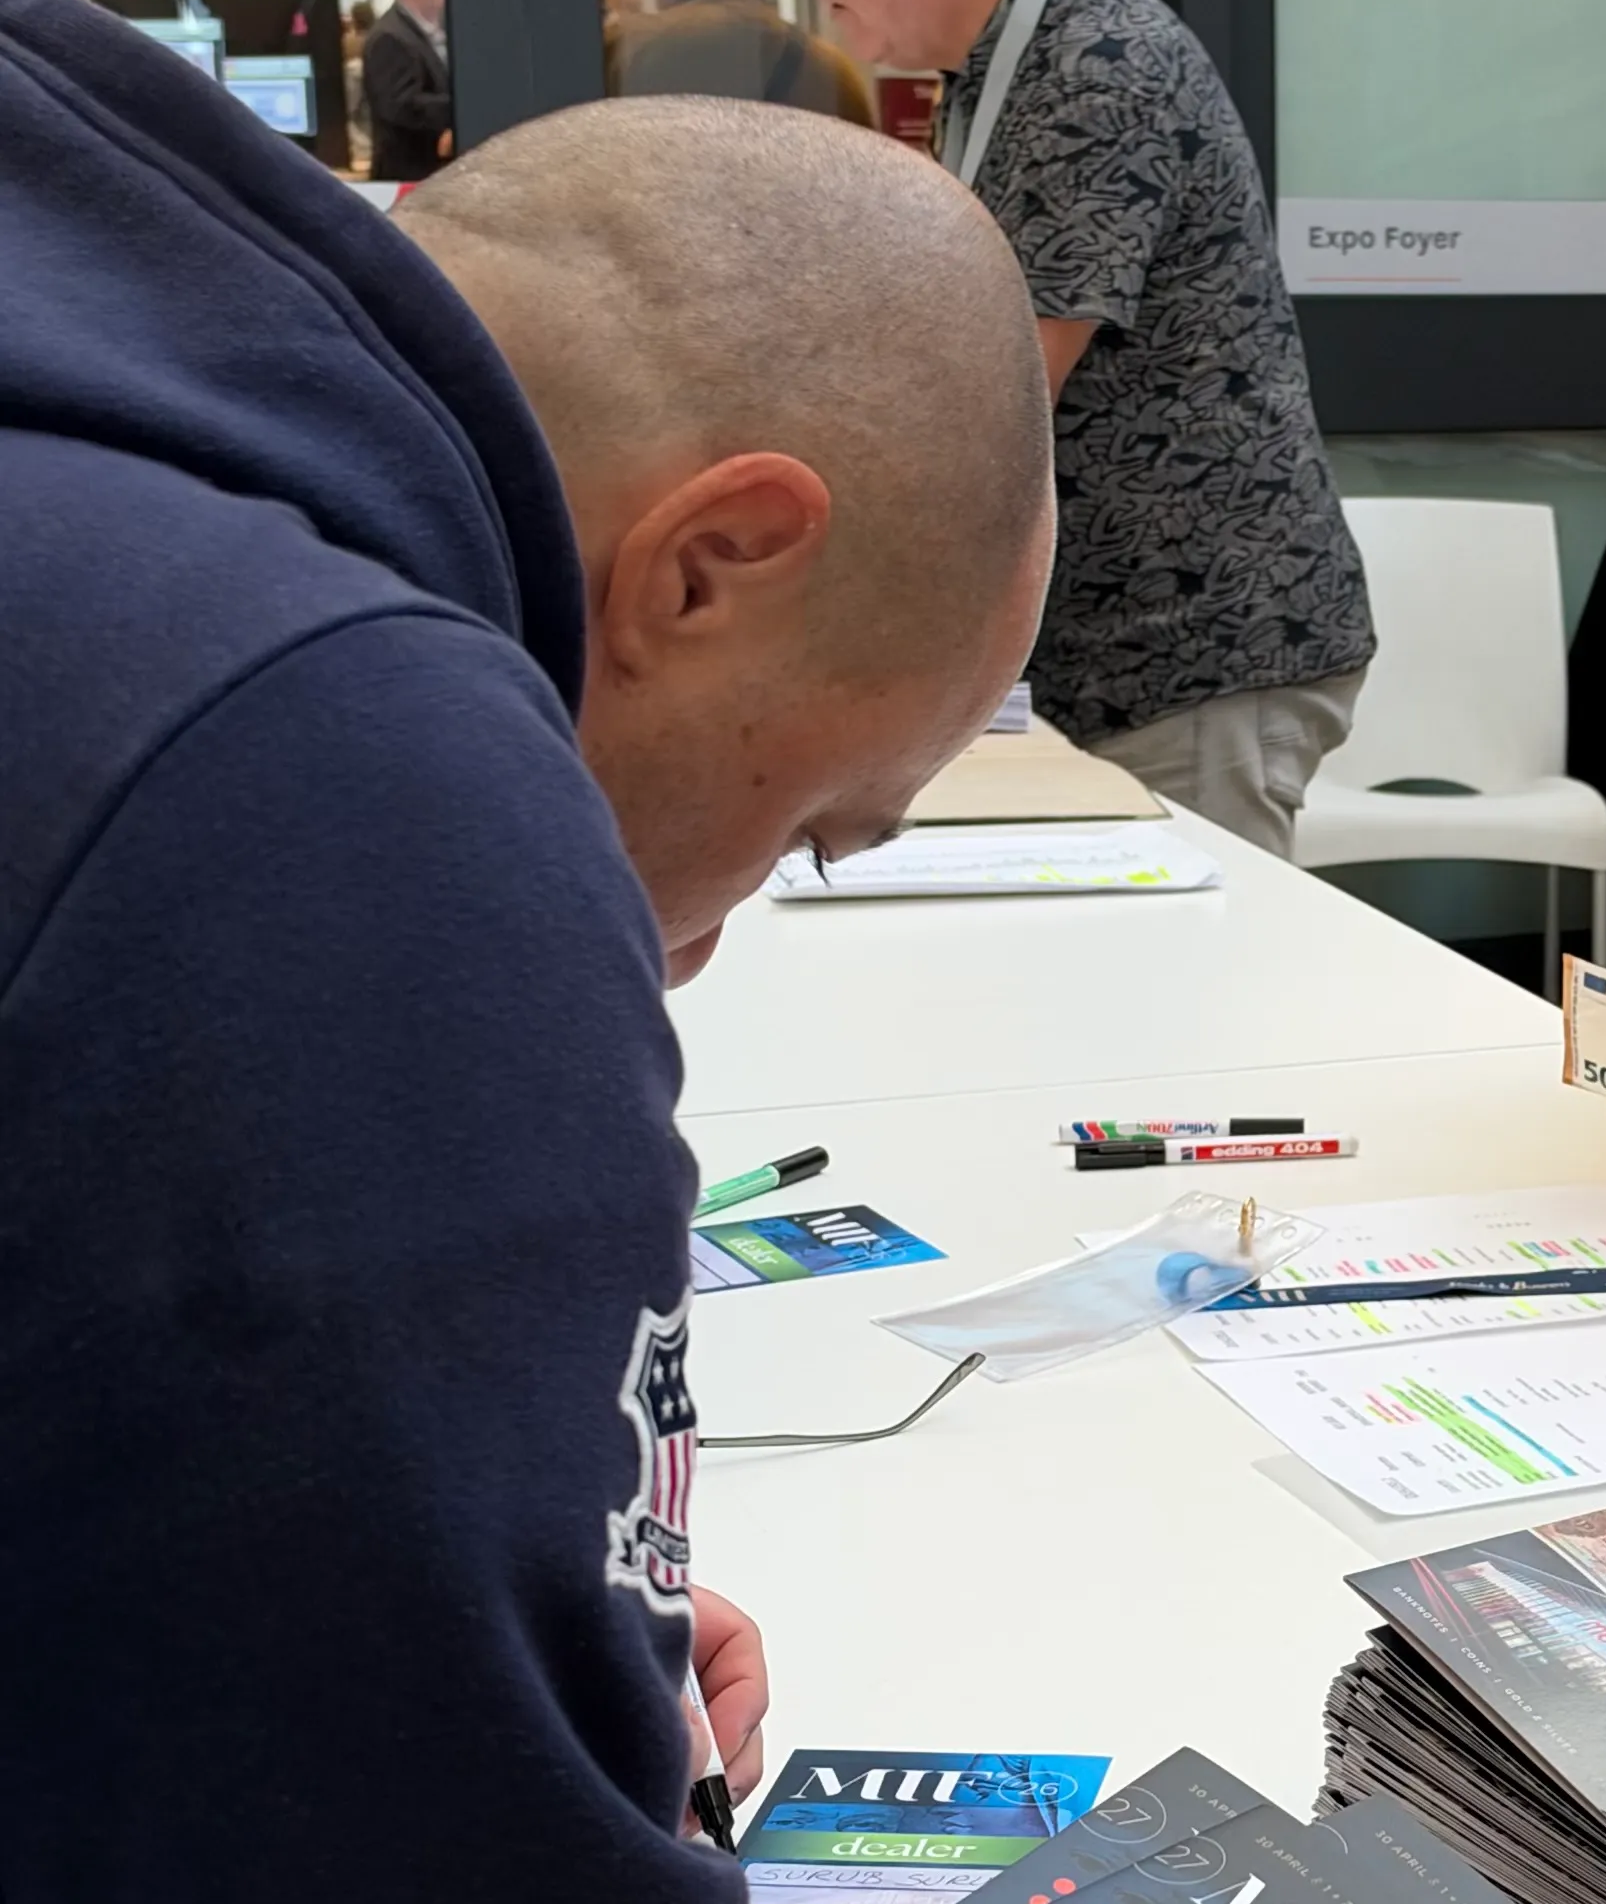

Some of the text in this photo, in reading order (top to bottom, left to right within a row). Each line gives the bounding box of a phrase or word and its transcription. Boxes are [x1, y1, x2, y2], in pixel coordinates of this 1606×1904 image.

[1308, 225, 1464, 257] Expo Foyer
[1211, 1140, 1324, 1159] edding 404
[1392, 1585, 1449, 1633] BANKNOTES
[1461, 1646, 1493, 1675] COINS
[1096, 1797, 1152, 1826] 27
[1207, 1797, 1238, 1820] APR
[831, 1835, 977, 1860] dealer
[1153, 1844, 1210, 1870] 27
[1374, 1829, 1393, 1844] 30
[1391, 1846, 1429, 1878] APRIL
[1273, 1848, 1310, 1878] APRIL
